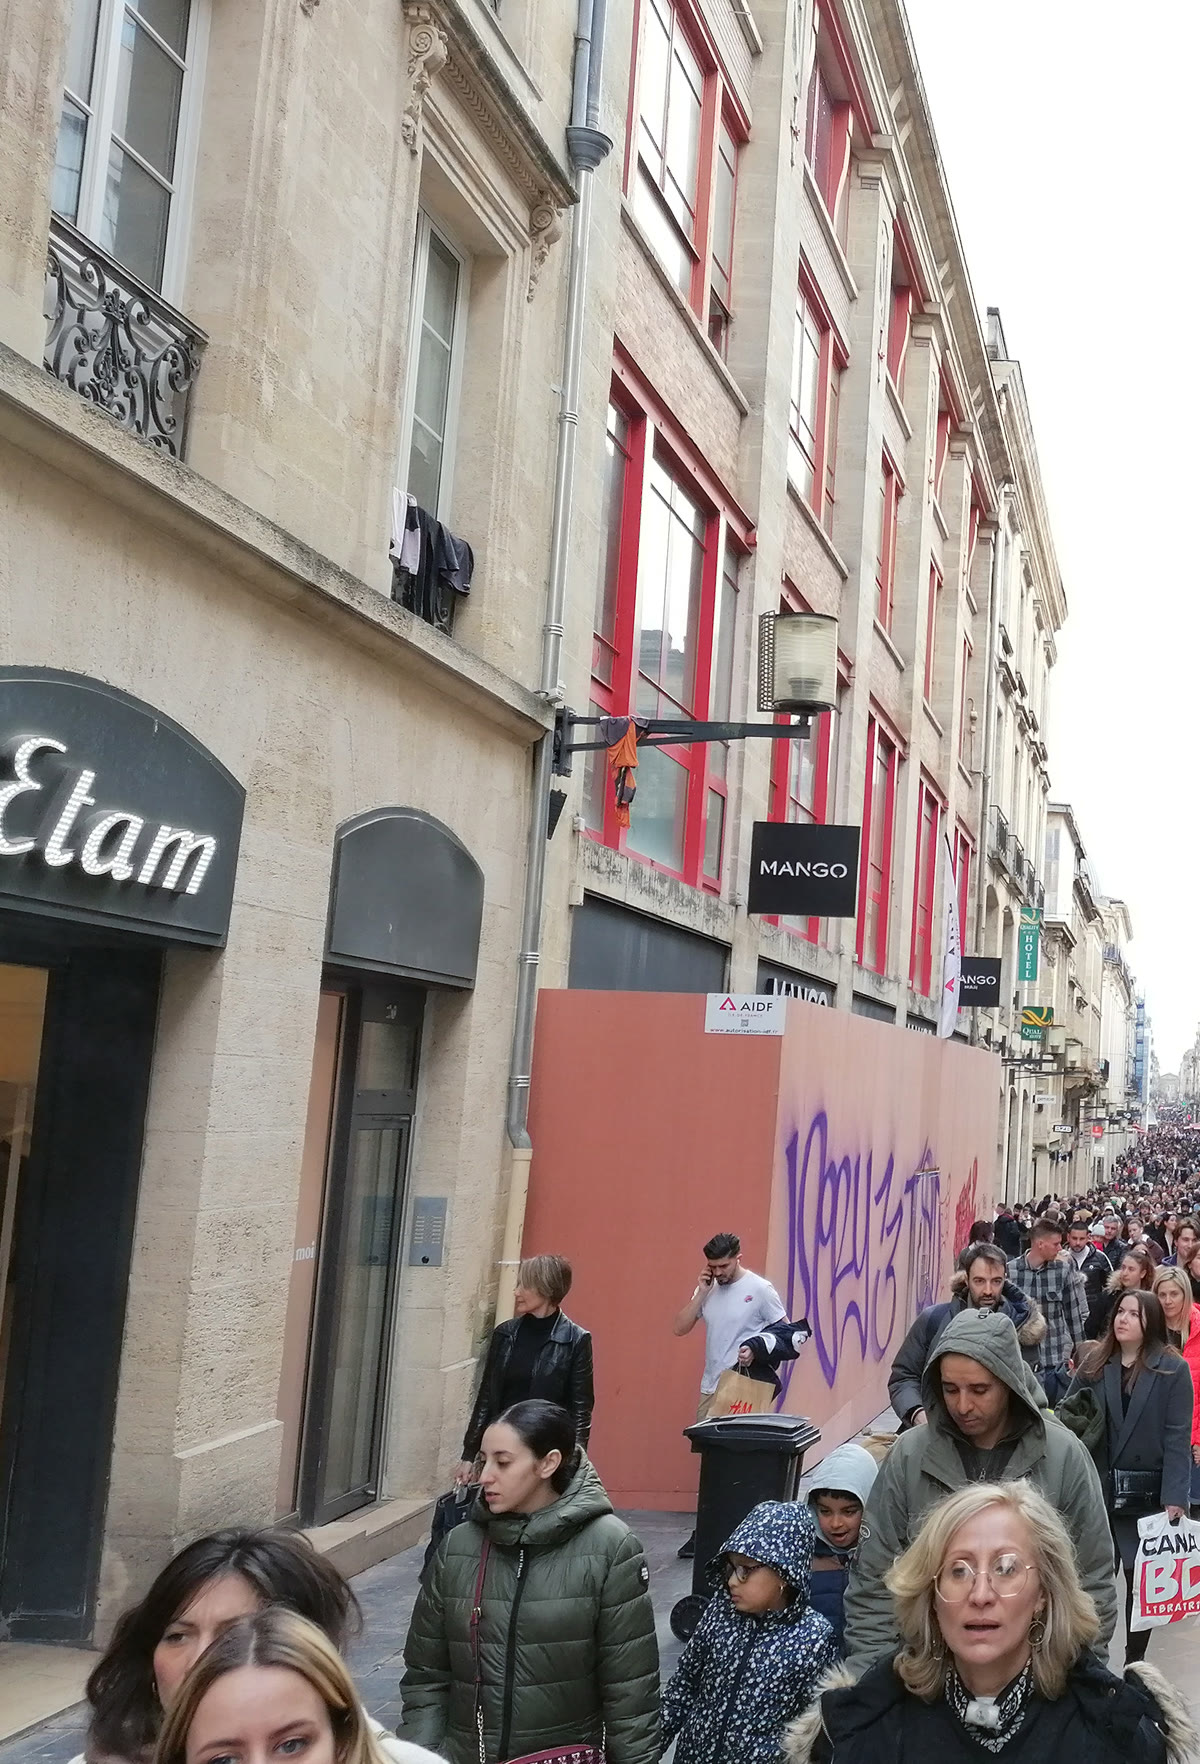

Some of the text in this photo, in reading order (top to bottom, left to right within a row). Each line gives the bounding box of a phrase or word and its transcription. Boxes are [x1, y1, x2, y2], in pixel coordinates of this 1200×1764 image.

[0, 736, 217, 895] Etam
[760, 860, 848, 879] MANGO
[1025, 935, 1033, 979] HOTEL
[958, 974, 997, 986] ANGO
[740, 1002, 774, 1012] AIDF
